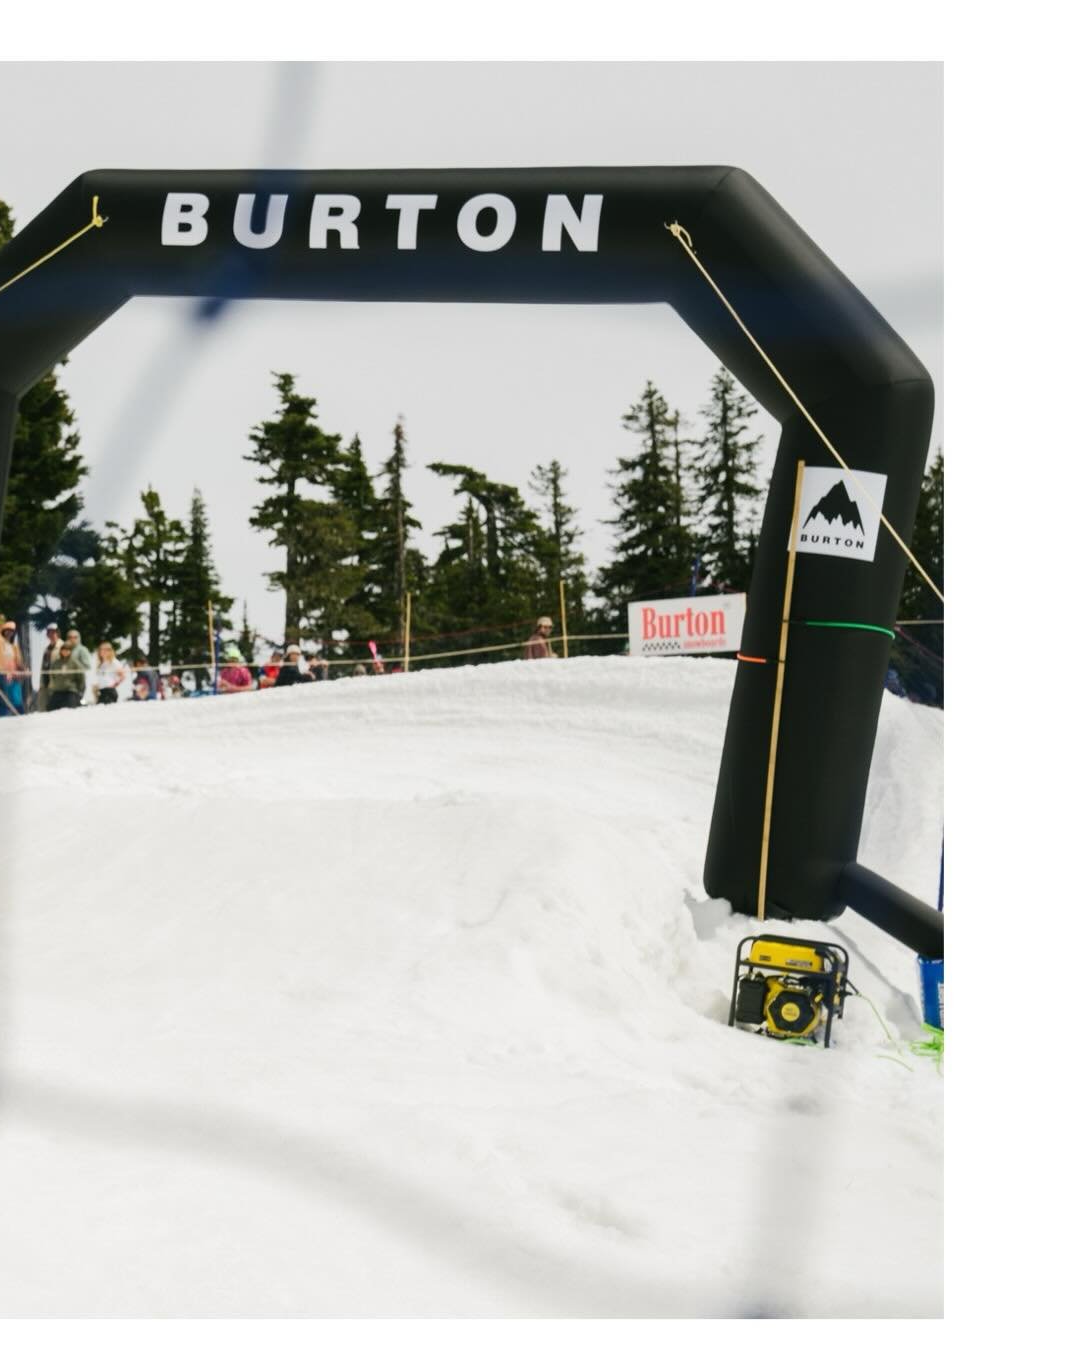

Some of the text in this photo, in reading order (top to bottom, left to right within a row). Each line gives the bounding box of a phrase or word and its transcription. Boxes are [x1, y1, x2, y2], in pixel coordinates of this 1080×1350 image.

[161, 192, 604, 252] BURTON
[800, 533, 864, 549] BURTON
[642, 607, 726, 640] Burton
